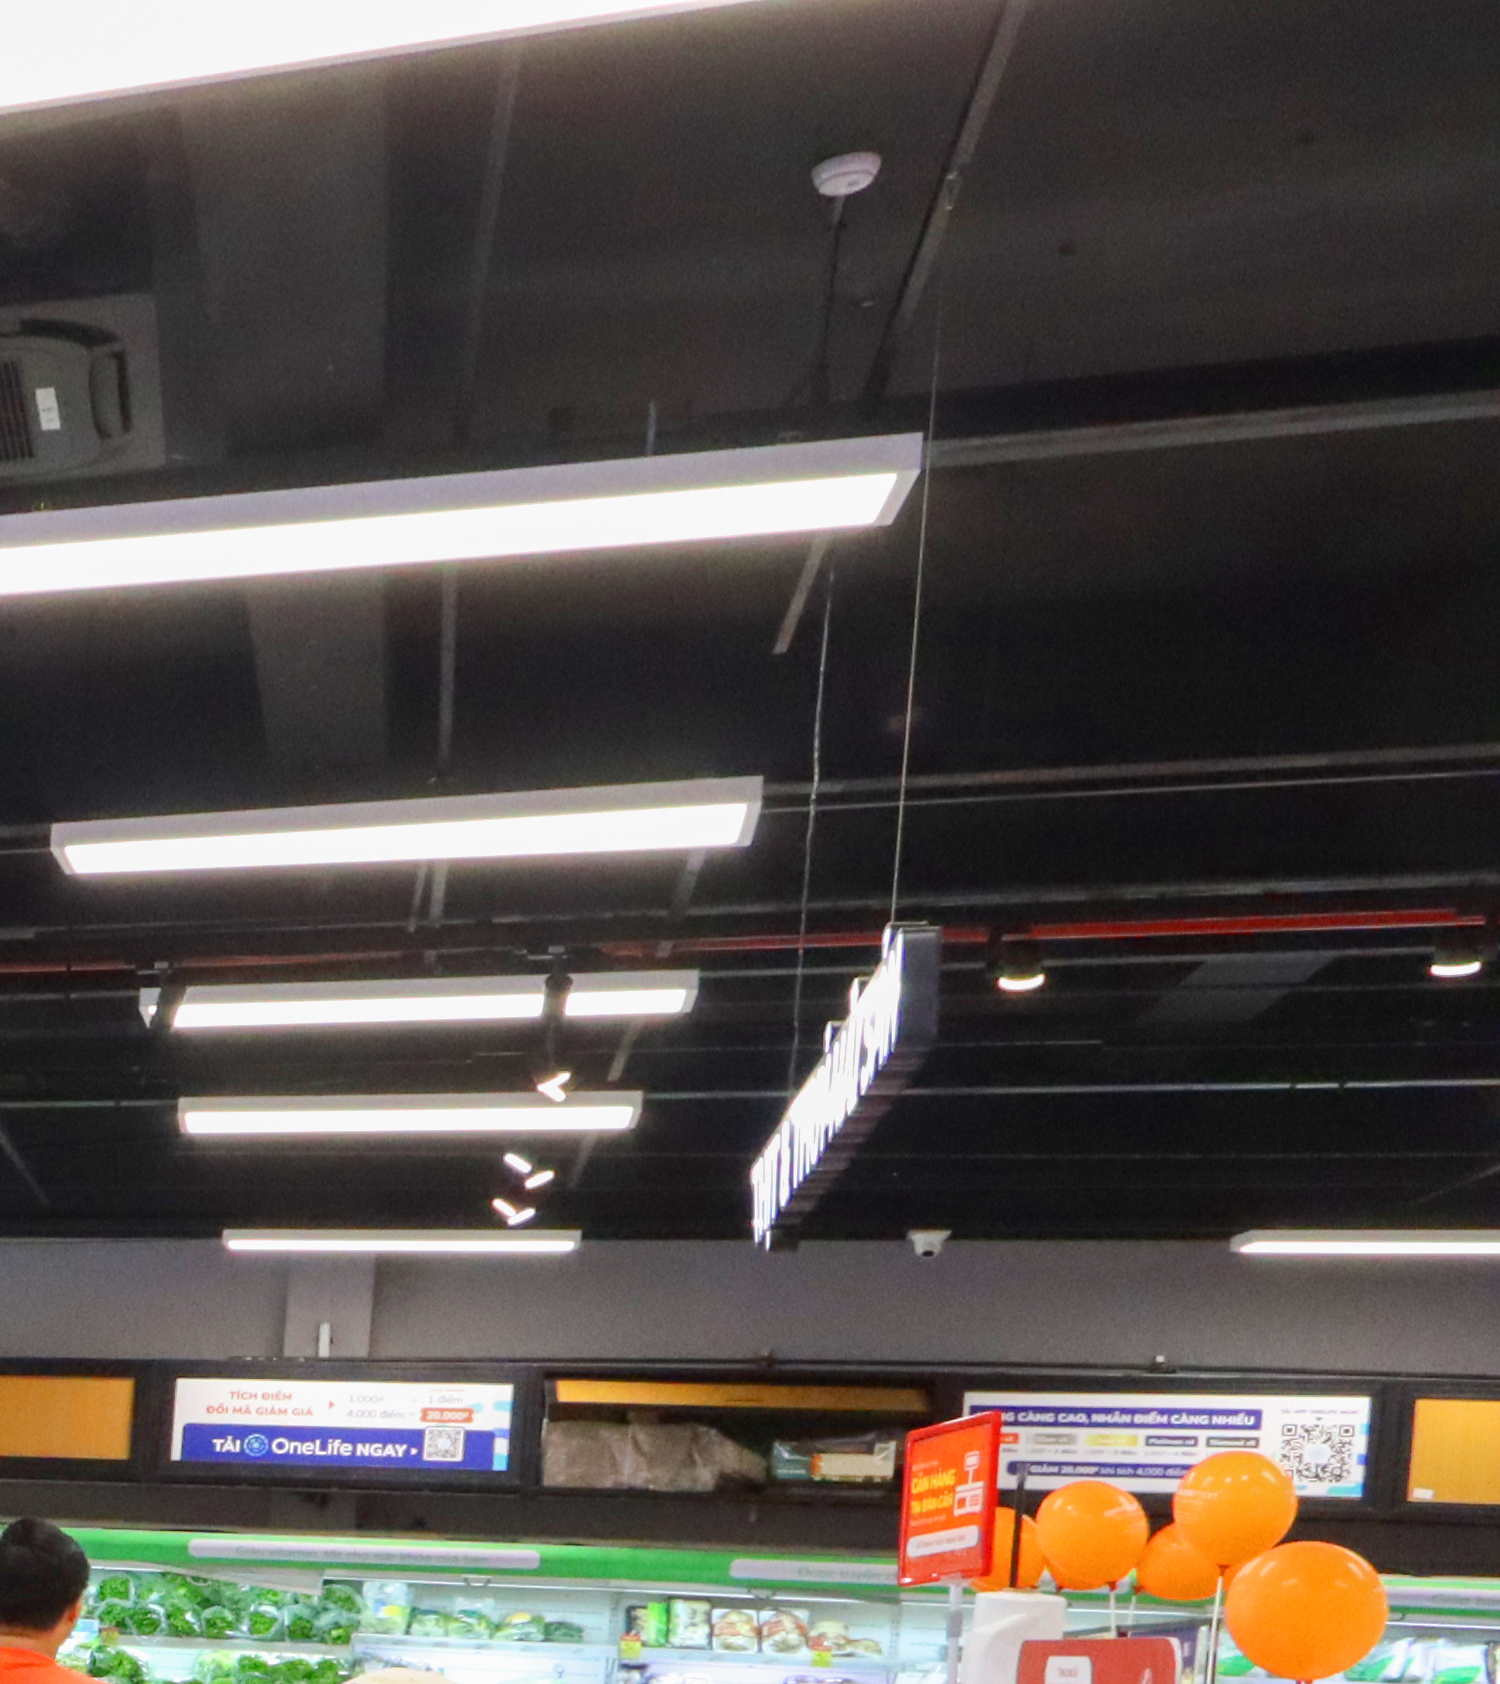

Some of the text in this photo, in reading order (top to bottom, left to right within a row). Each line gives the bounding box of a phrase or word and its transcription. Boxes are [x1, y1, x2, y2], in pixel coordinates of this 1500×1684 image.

[228, 1388, 293, 1402] TÍCH ĐIỂM
[206, 1403, 314, 1418] ĐỔI MÃ GIẢM GIÁ
[1057, 1412, 1089, 1426] CAO,
[212, 1434, 407, 1458] TẢI OneLife NGAY
